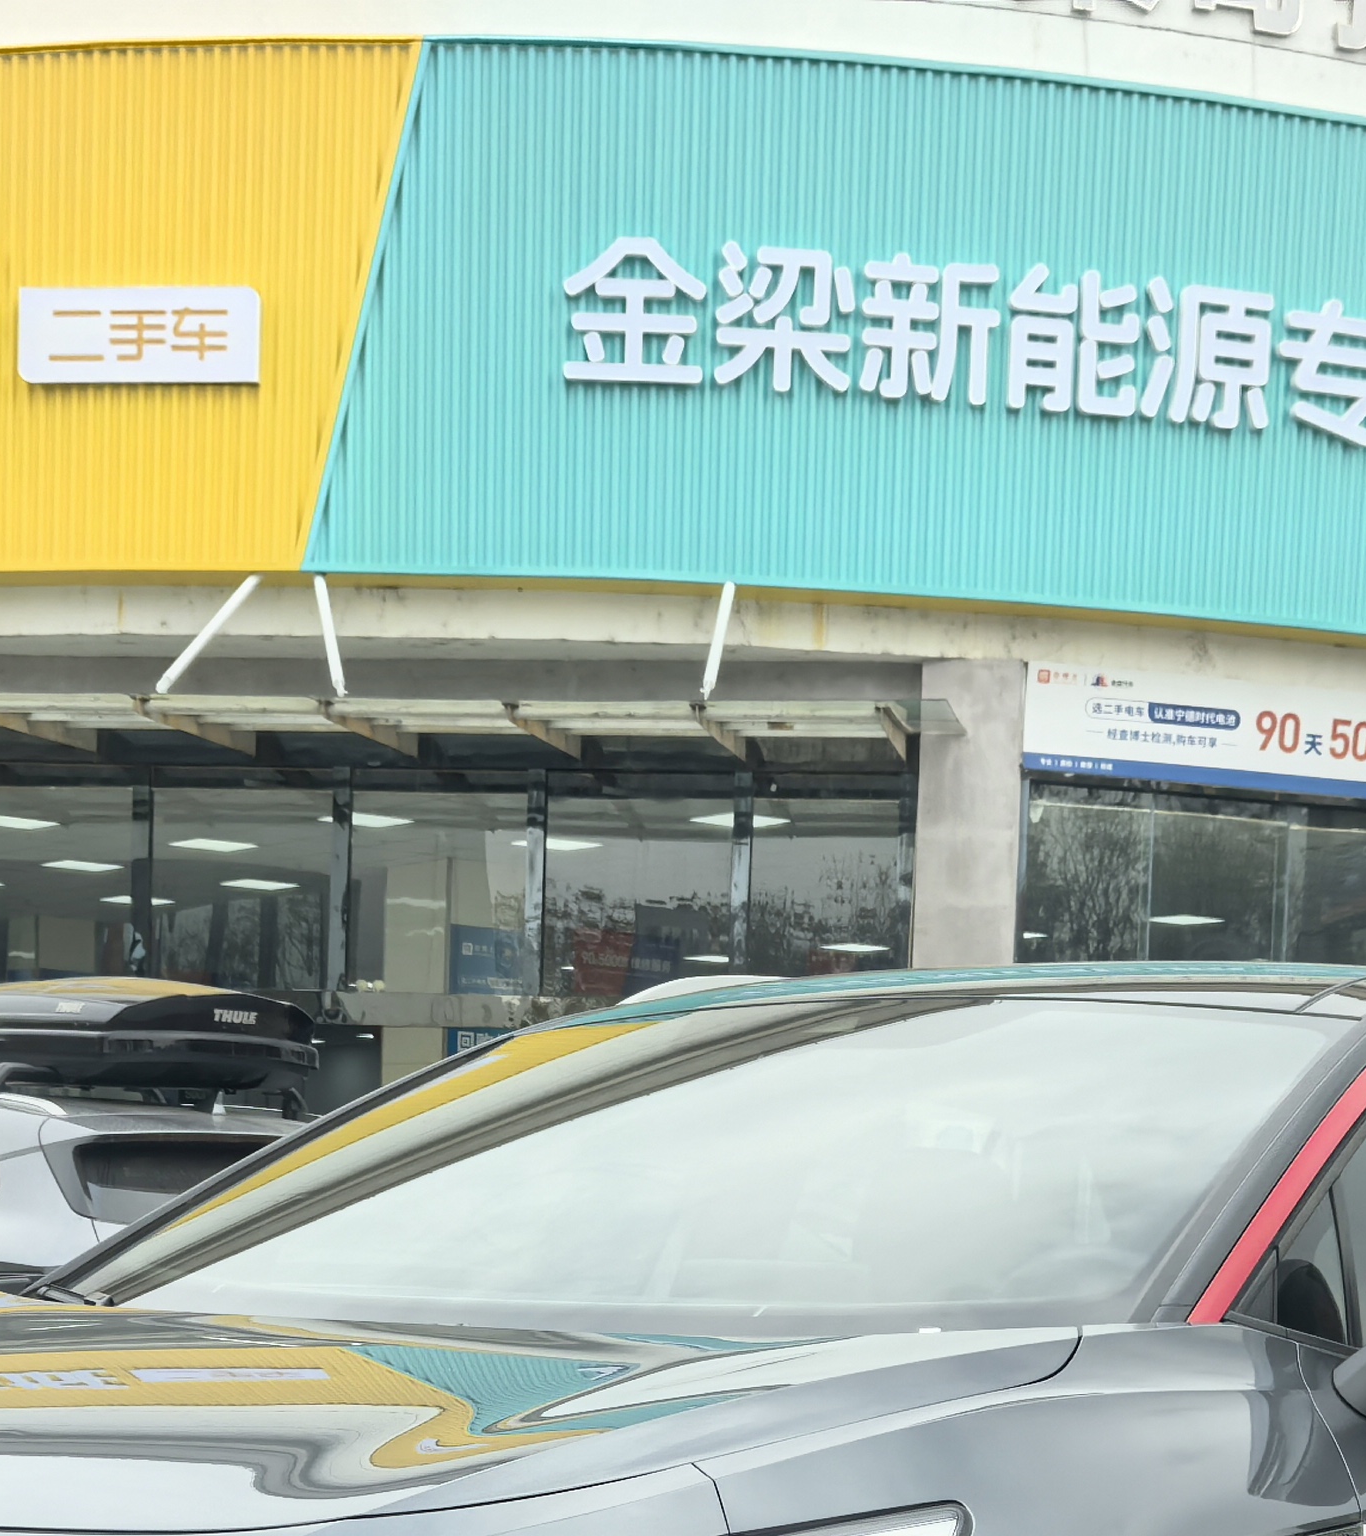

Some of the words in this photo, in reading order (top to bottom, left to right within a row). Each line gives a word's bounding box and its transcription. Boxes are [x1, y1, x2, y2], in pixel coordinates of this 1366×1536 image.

[47, 306, 229, 363] 二手车
[1091, 702, 1146, 720] 选二手电车
[213, 1007, 259, 1026] THULE
